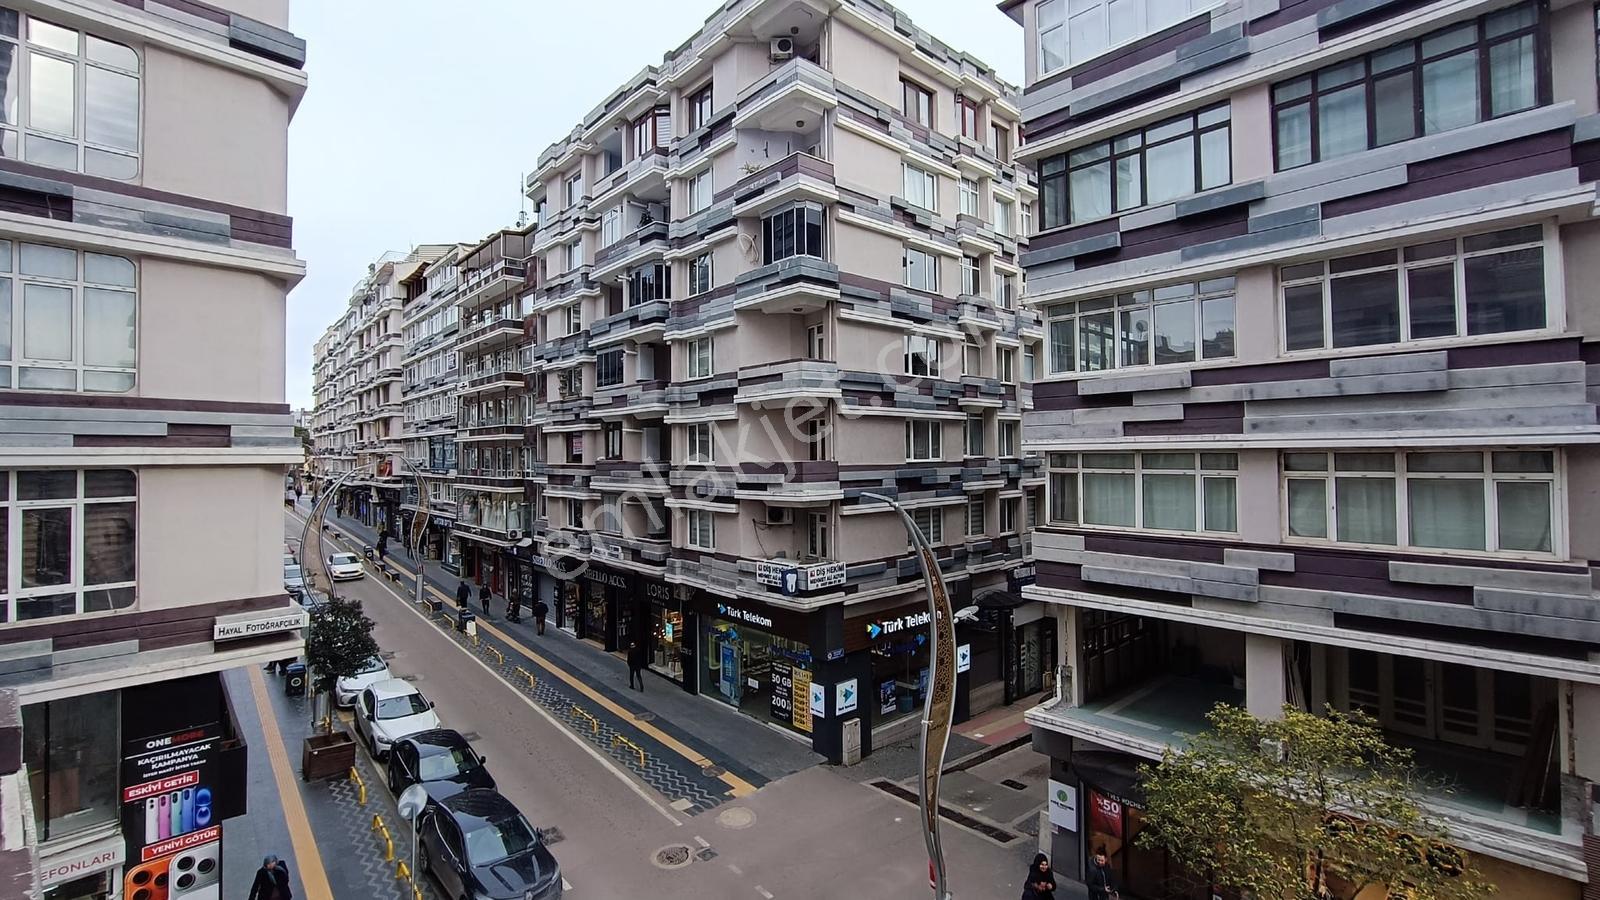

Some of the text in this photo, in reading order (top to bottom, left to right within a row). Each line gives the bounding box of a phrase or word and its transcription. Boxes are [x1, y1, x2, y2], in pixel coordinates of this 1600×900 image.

[647, 583, 670, 600] LORIS
[726, 606, 772, 628] Türk Telekom
[218, 627, 242, 637] HAYAL
[882, 617, 904, 635] Türk
[771, 673, 781, 684] 50
[781, 676, 792, 688] GB
[771, 695, 787, 709] 200
[138, 743, 212, 766] KAÇIRILMAYACAK
[151, 754, 199, 770] KAMPANYA
[128, 774, 194, 798] ESKİYİ GETİR
[152, 828, 217, 855] YENİYİ GÖTÜR
